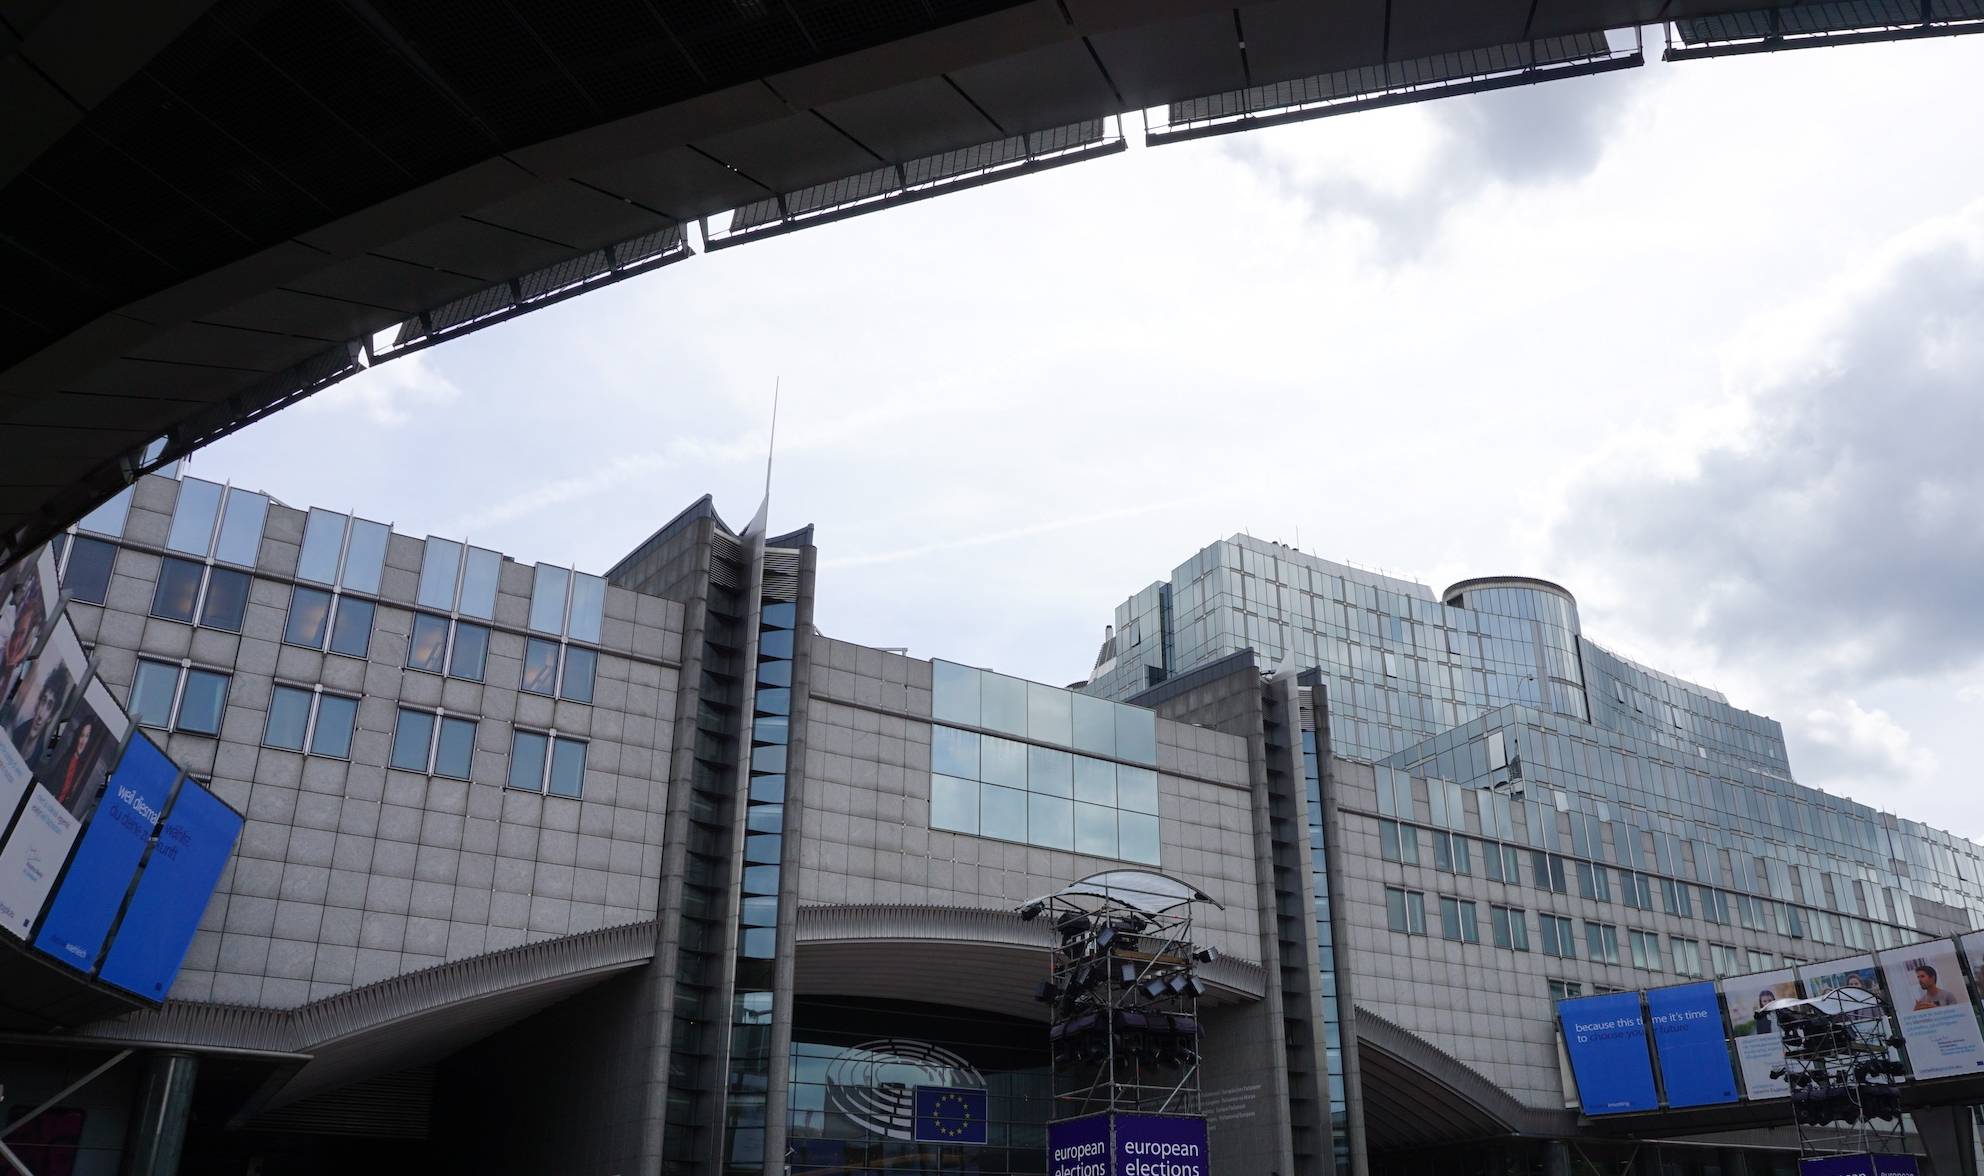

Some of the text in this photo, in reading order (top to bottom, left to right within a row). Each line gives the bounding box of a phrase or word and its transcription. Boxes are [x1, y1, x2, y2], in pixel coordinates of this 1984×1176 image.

[117, 784, 137, 806] weil
[133, 795, 162, 826] diesmal
[1575, 1022, 1616, 1033] because
[1616, 1017, 1635, 1029] this
[1669, 1011, 1684, 1023] it's
[1685, 1009, 1708, 1021] time
[1577, 1034, 1588, 1043] to
[1589, 1030, 1625, 1041] choose
[1659, 1022, 1689, 1034] future
[1054, 1141, 1105, 1161] european
[1124, 1141, 1199, 1159] european
[1055, 1162, 1106, 1176] elections
[1125, 1158, 1200, 1176] elections
